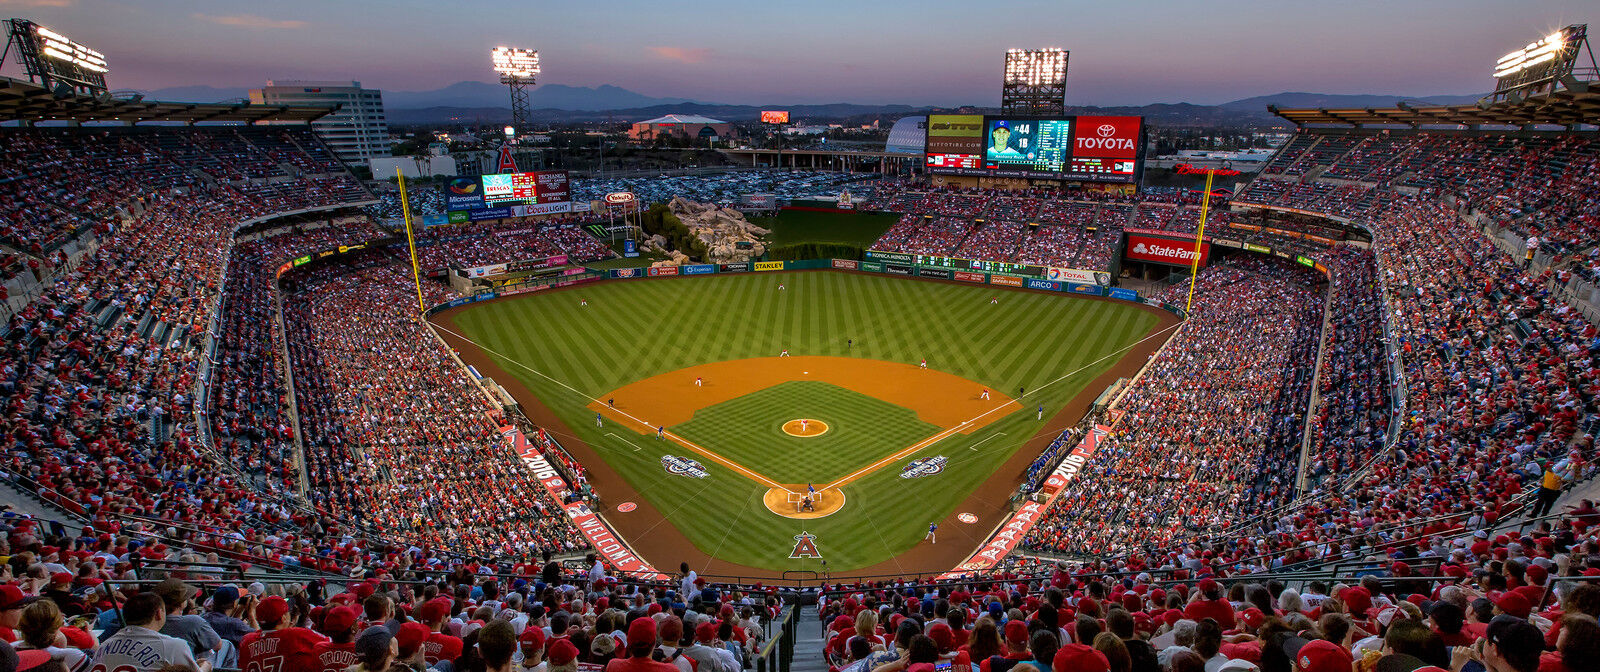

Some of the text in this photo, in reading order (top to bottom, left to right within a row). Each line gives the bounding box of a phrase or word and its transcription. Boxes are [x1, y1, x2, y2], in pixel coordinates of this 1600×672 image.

[1077, 137, 1135, 150] TOYOTA
[1175, 163, 1241, 176] Budweiser
[526, 205, 549, 215] Coors
[549, 204, 568, 212] LIGHT
[1030, 280, 1052, 290] ARCO
[522, 454, 560, 480] 2016
[1051, 454, 1086, 481] 2016
[580, 517, 636, 567] WELCOME
[788, 533, 822, 559] A
[248, 637, 281, 659] TROUT
[318, 650, 359, 667] TROUT
